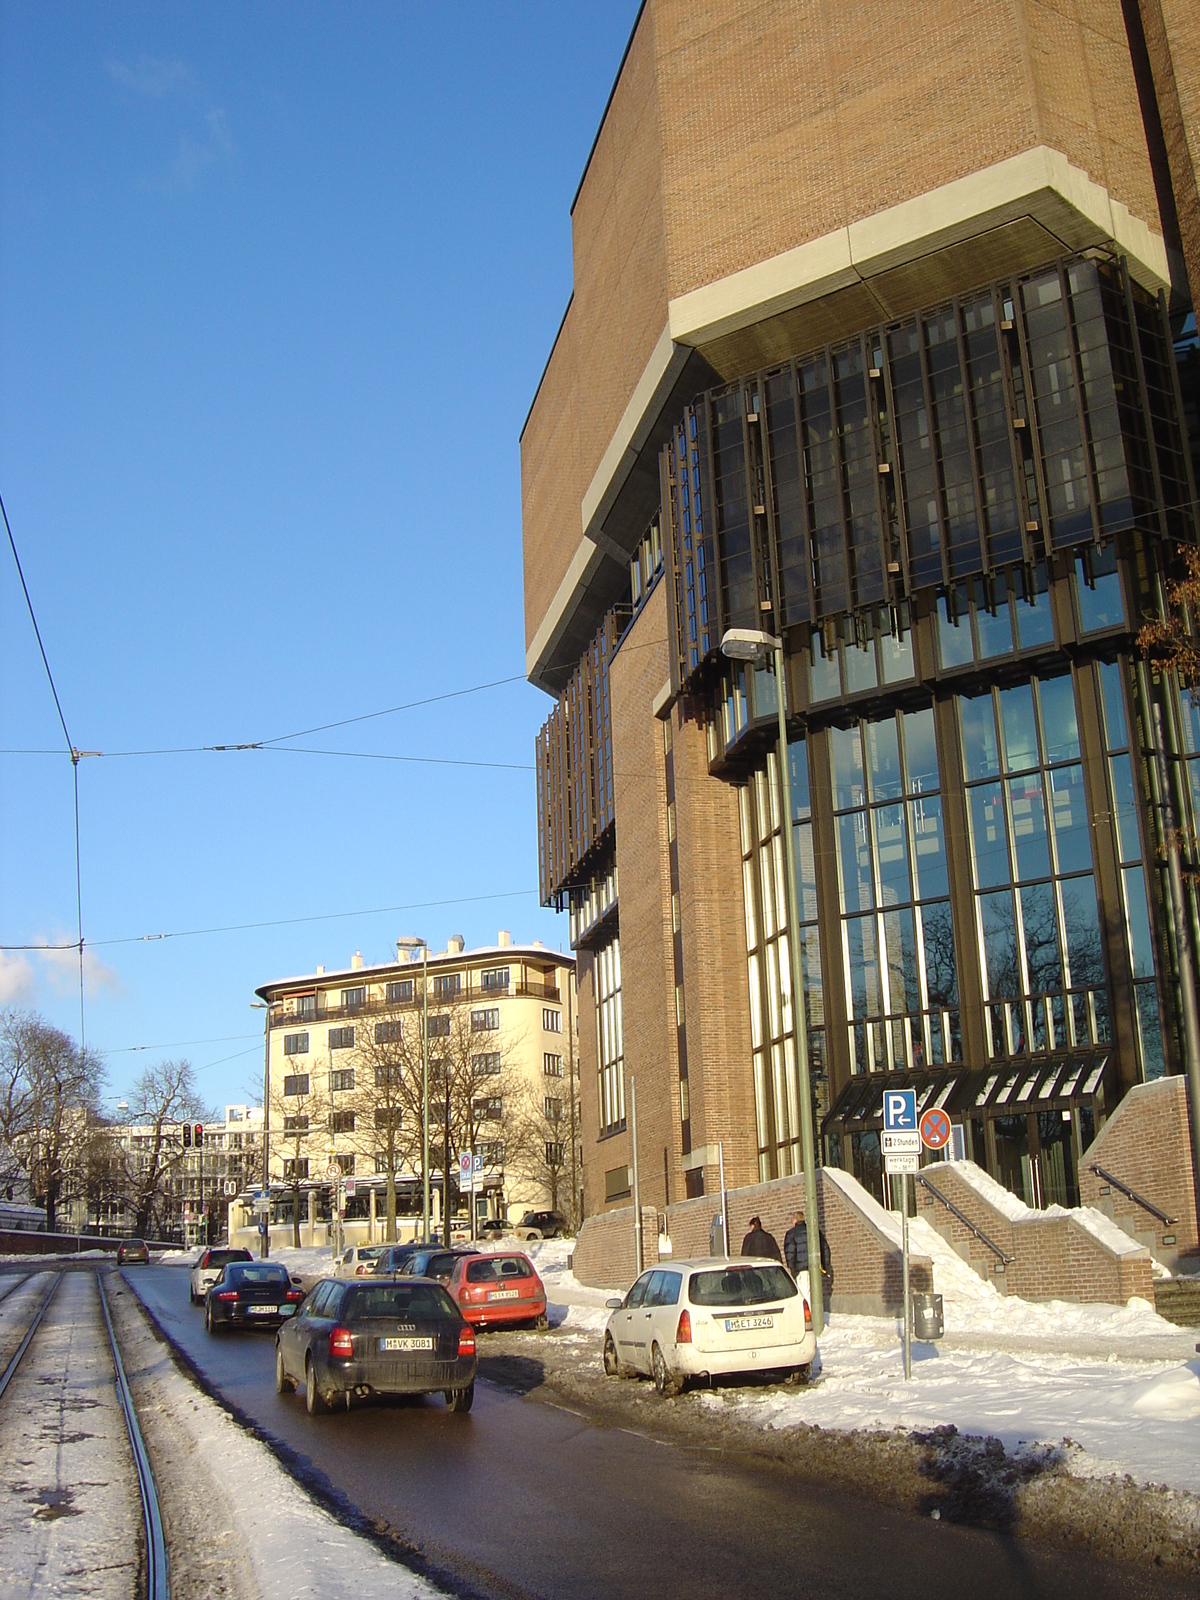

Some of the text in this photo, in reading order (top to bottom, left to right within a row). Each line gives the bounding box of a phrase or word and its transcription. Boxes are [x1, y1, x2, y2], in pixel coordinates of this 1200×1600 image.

[889, 1095, 907, 1126] P
[893, 1138, 918, 1146] 2 Stunden
[474, 1157, 481, 1171] P
[741, 1319, 750, 1328] ET
[753, 1317, 772, 1327] 3246
[397, 1340, 409, 1348] VK
[410, 1339, 431, 1348] 3081
[751, 1351, 757, 1359] D
